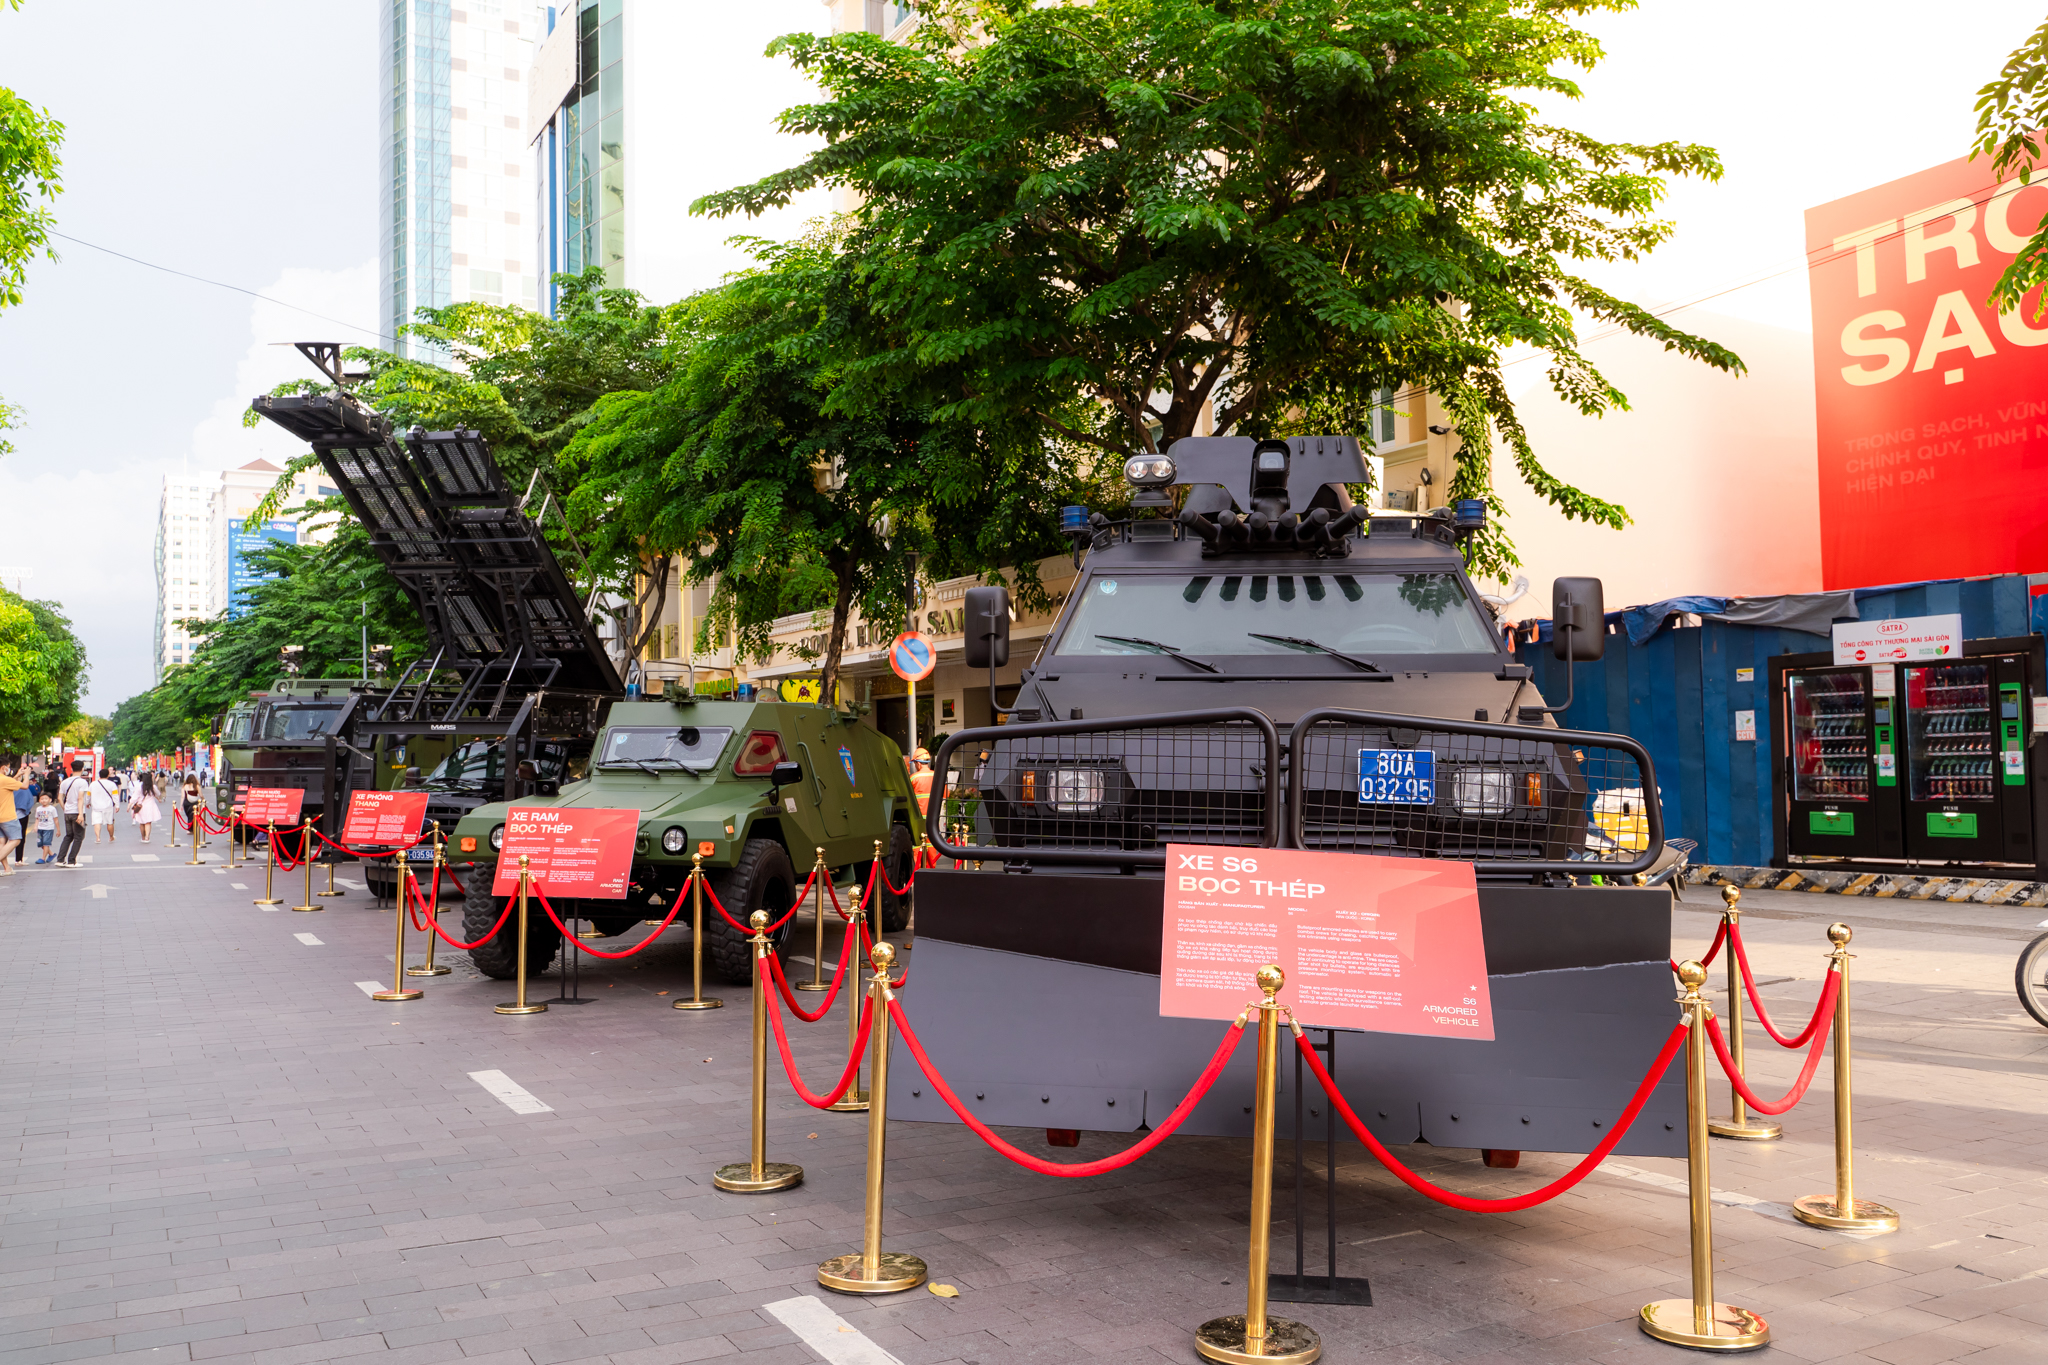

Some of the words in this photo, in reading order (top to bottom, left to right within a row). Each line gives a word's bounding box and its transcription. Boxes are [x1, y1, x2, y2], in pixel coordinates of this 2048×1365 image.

[1844, 428, 1915, 452] TRONG
[1922, 413, 1990, 438] SẠCH,
[1997, 400, 2048, 422] VỮN
[1846, 450, 1910, 473] CHÍNH
[1917, 439, 1966, 460] QUY,
[1973, 427, 2028, 449] TINH
[1846, 473, 1893, 494] HIỆN
[1900, 466, 1935, 485] ĐẠI
[800, 629, 854, 656] ROYL
[856, 616, 926, 648] HOL
[927, 595, 1021, 635] SAIN
[1882, 624, 1903, 632] SATRA
[1737, 731, 1754, 739] CCTV
[1376, 753, 1416, 776] 80A
[1361, 777, 1431, 801] 032.95
[511, 812, 528, 821] XE
[531, 812, 559, 821] RAM
[510, 824, 537, 835] BỌC
[540, 822, 573, 834] THÉP
[1178, 854, 1214, 870] XE
[1222, 856, 1258, 873] S6
[1179, 876, 1240, 896] BỌC
[1249, 879, 1326, 898] THÉP
[1423, 1005, 1478, 1016] ARMORED
[1463, 997, 1476, 1005] S6
[1432, 1016, 1479, 1026] VEHICLE
